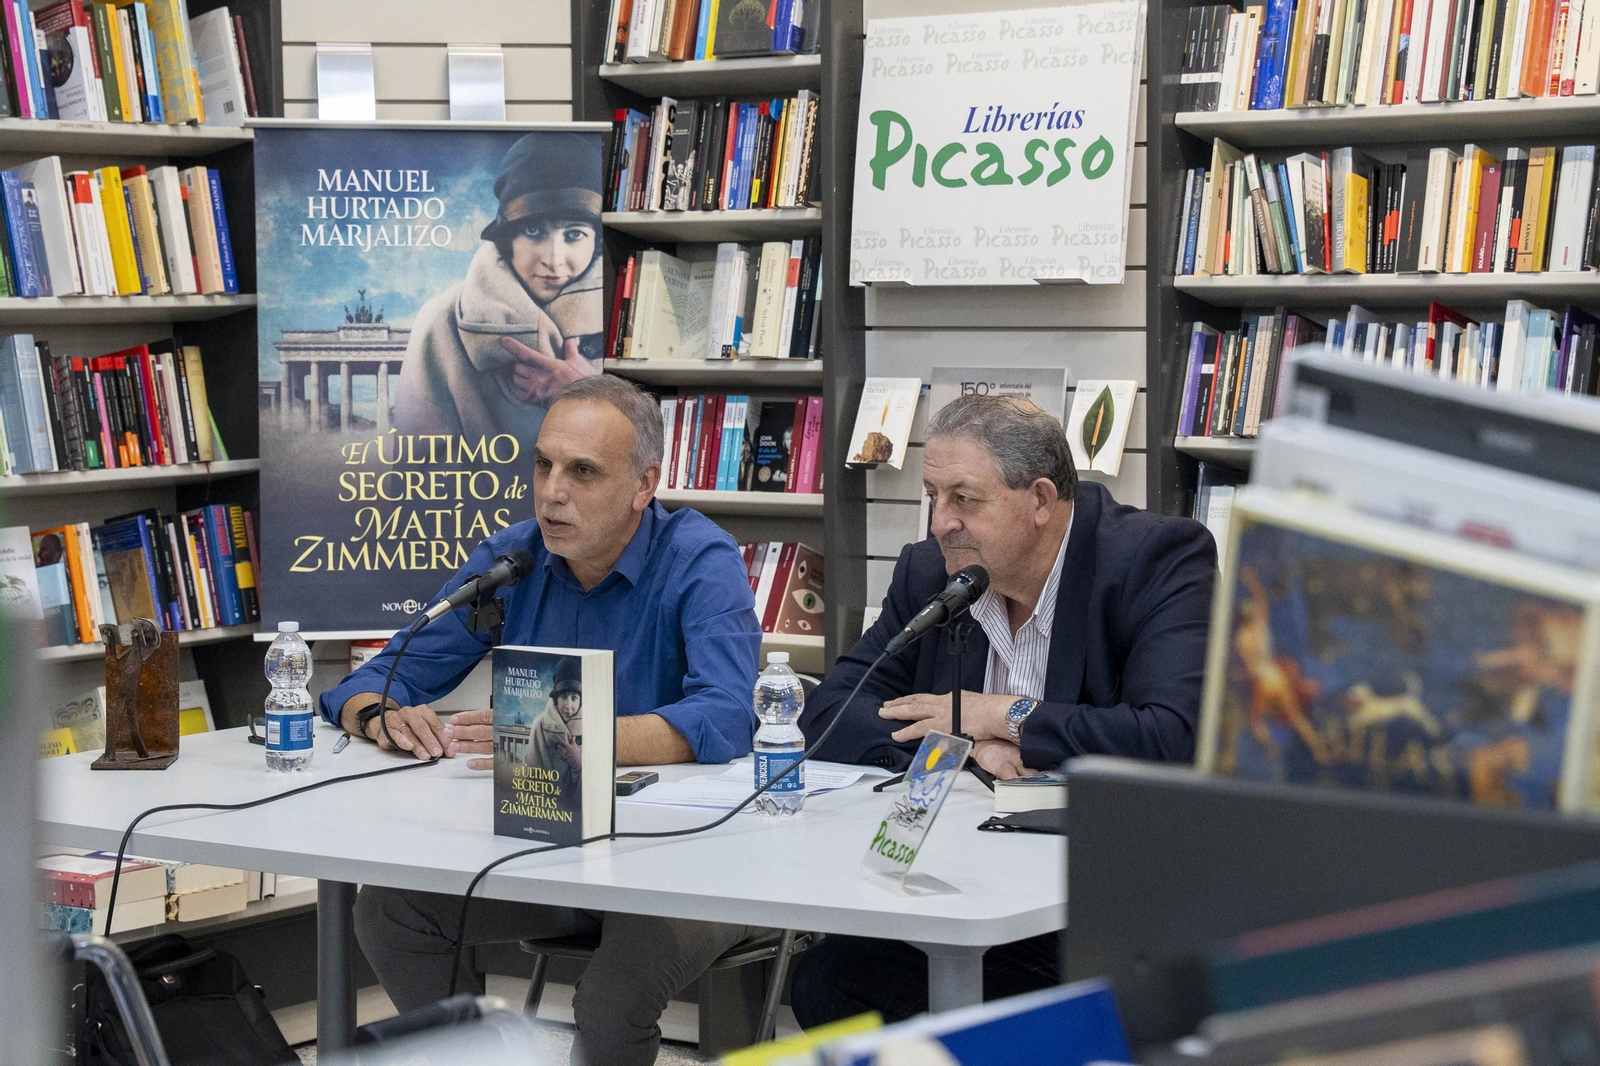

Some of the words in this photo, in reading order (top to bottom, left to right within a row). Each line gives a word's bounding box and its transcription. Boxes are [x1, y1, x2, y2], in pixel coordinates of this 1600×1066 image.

[923, 23, 986, 45] Picasso
[999, 19, 1064, 41] Picasso
[872, 57, 933, 78] Picasso
[946, 53, 1010, 74] Picasso
[1022, 48, 1088, 70] Picasso
[962, 102, 1086, 134] Librerías
[869, 109, 1114, 191] Picasso
[316, 169, 434, 192] MANUEL
[704, 183, 715, 204] Cartas
[1335, 188, 1345, 221] POESÍA
[308, 197, 445, 220] HURTADO
[301, 224, 452, 252] MARJALIZO
[899, 228, 962, 249] Picasso
[974, 226, 1039, 248] Picasso
[1052, 224, 1118, 247] Picasso
[1334, 223, 1344, 258] BISHOP
[999, 257, 1065, 278] Picasso
[1477, 247, 1485, 268] BOLAÑO
[851, 260, 911, 280] Picasso
[923, 258, 986, 280] Picasso
[342, 439, 376, 465] El
[377, 428, 520, 465] ÚLTIMO
[339, 470, 500, 502] SECRETO
[504, 476, 527, 500] de
[228, 504, 248, 548] MADRID
[350, 502, 511, 542] MATÍAS
[505, 677, 541, 689] HURTADO
[508, 667, 538, 679] MANUEL
[504, 687, 543, 699] MARJALIZO
[521, 764, 559, 782] ÚLTIMO
[512, 778, 554, 794] SECRETO
[554, 786, 561, 796] de
[500, 800, 573, 823] ZIMMERMANN
[516, 792, 557, 809] MATÍAS
[870, 821, 915, 865] Picasso
